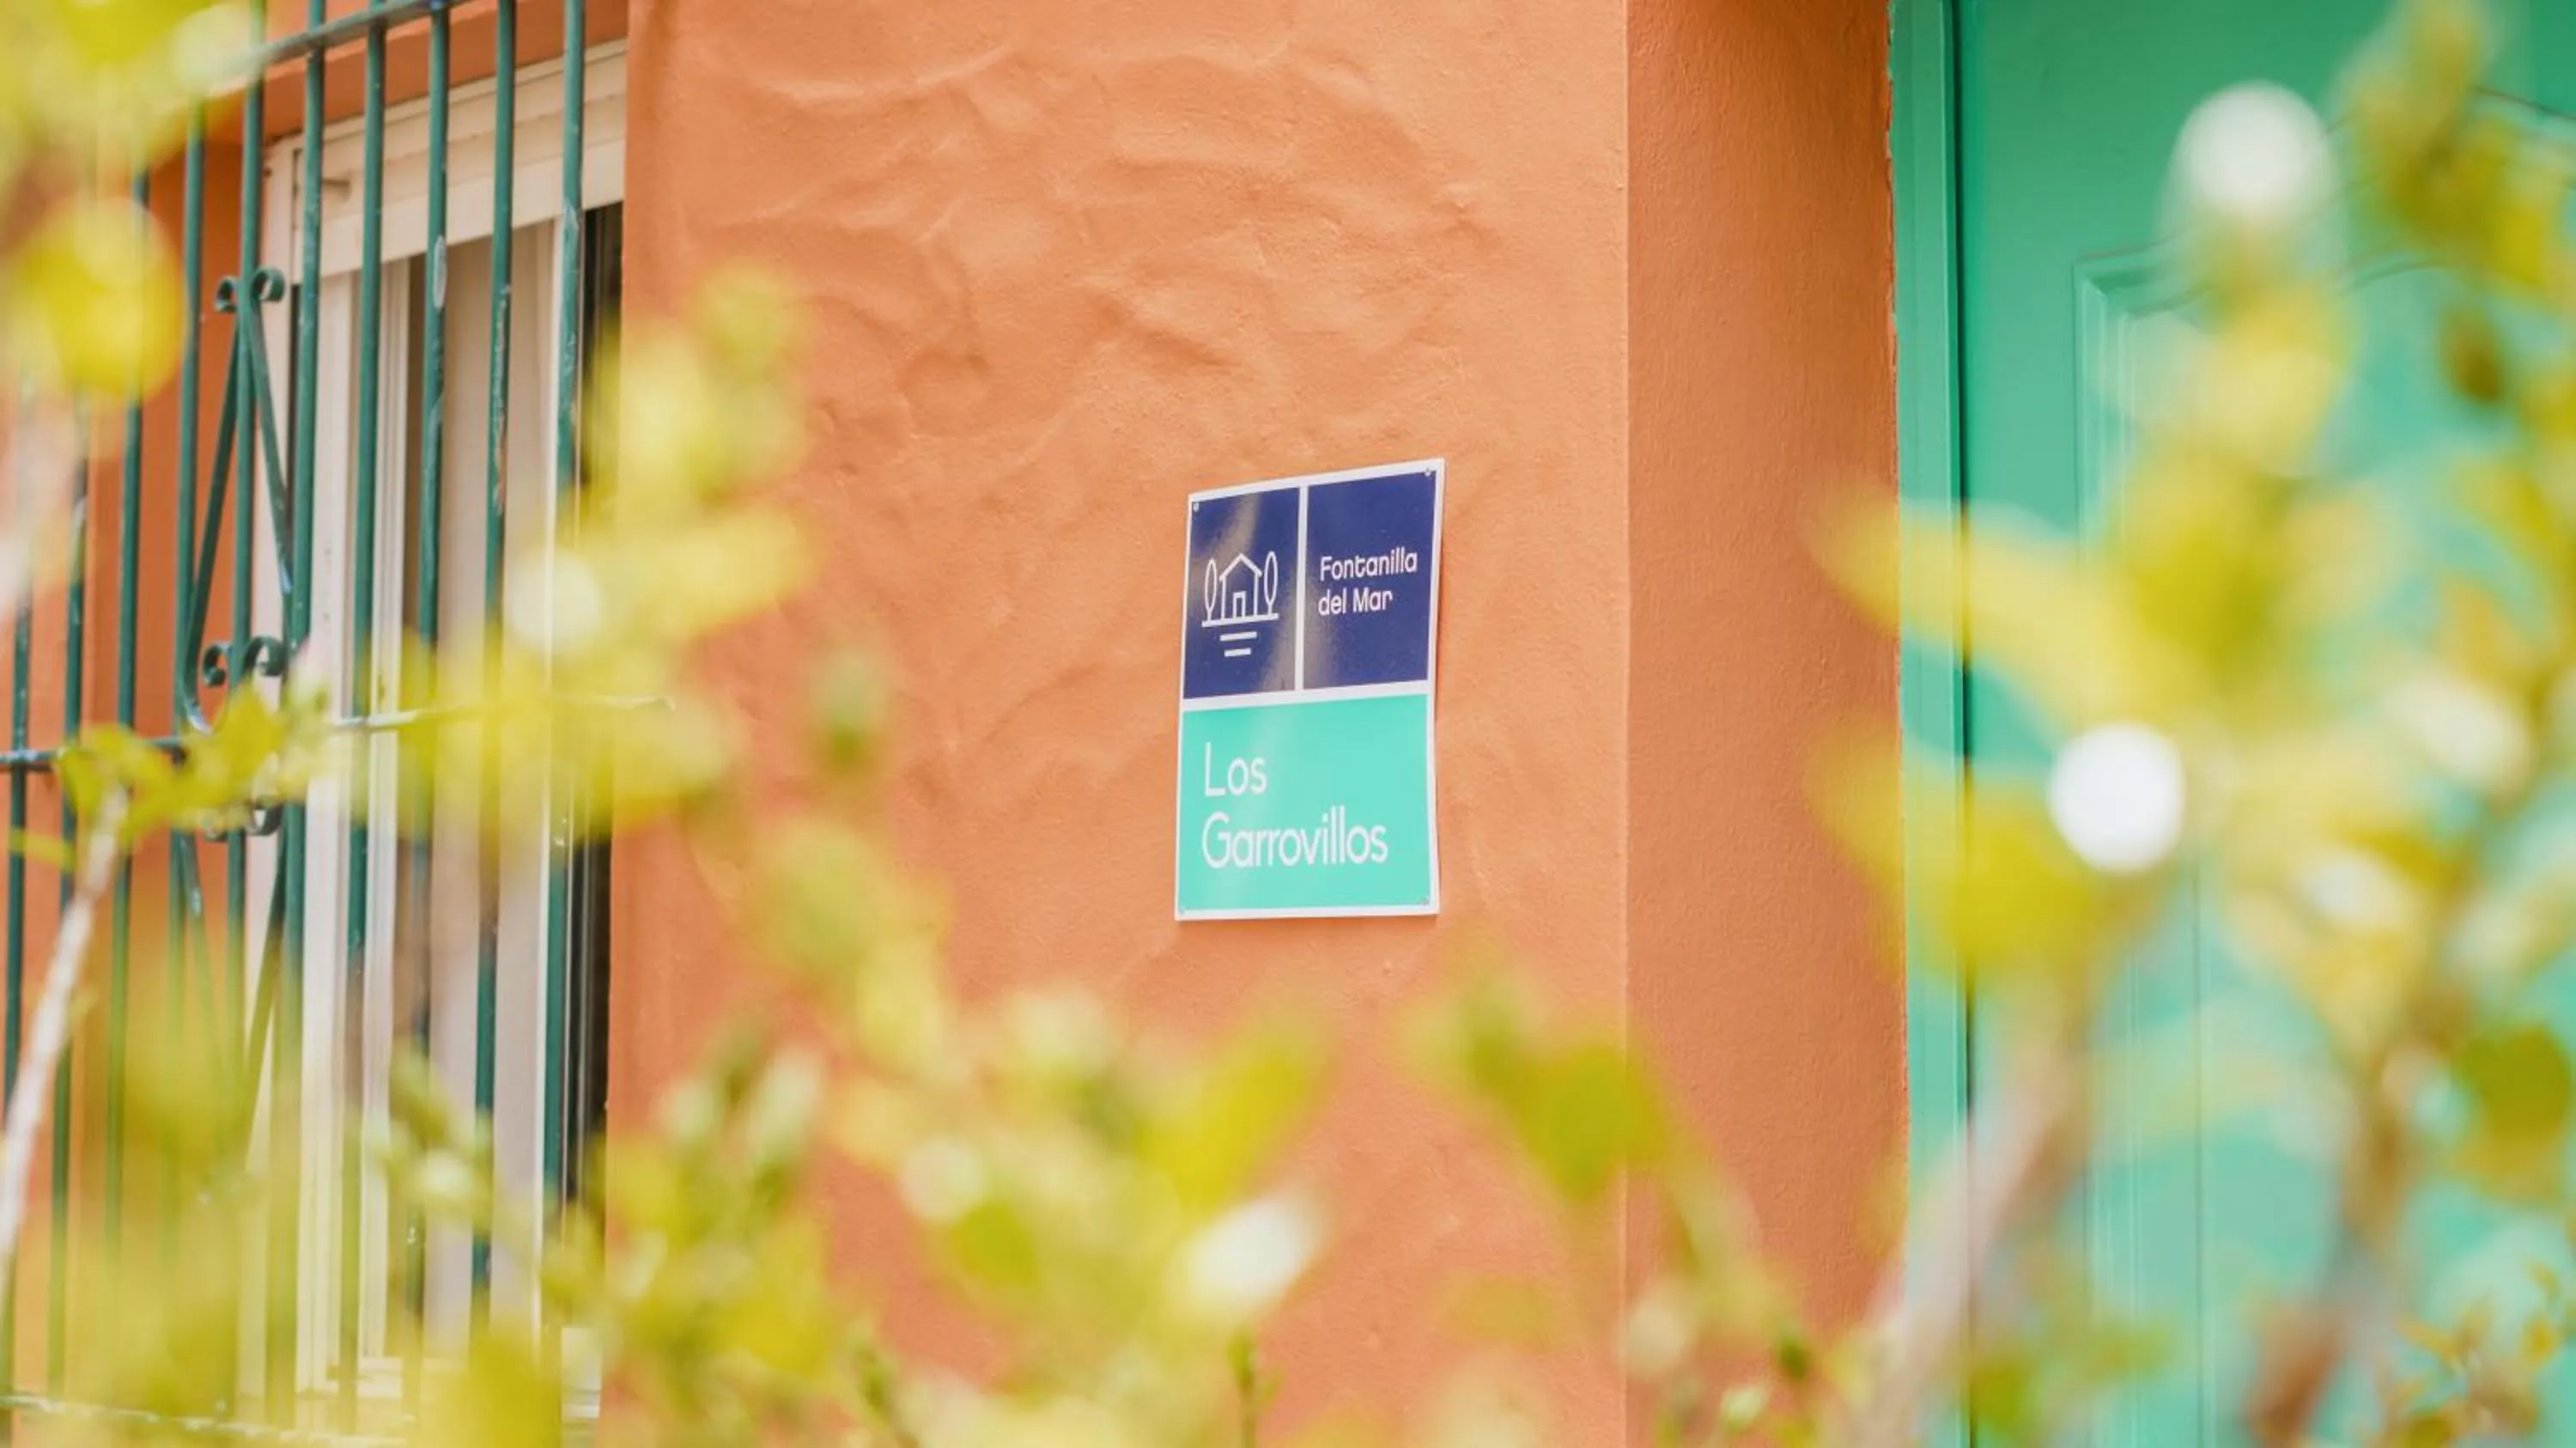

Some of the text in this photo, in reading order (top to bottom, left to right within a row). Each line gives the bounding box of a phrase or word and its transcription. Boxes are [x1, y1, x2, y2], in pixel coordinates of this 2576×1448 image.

[1319, 546, 1418, 581] Fontanilla
[1317, 587, 1393, 617] del Mar
[1204, 741, 1268, 797] Los
[1201, 805, 1388, 869] Garrovillos
